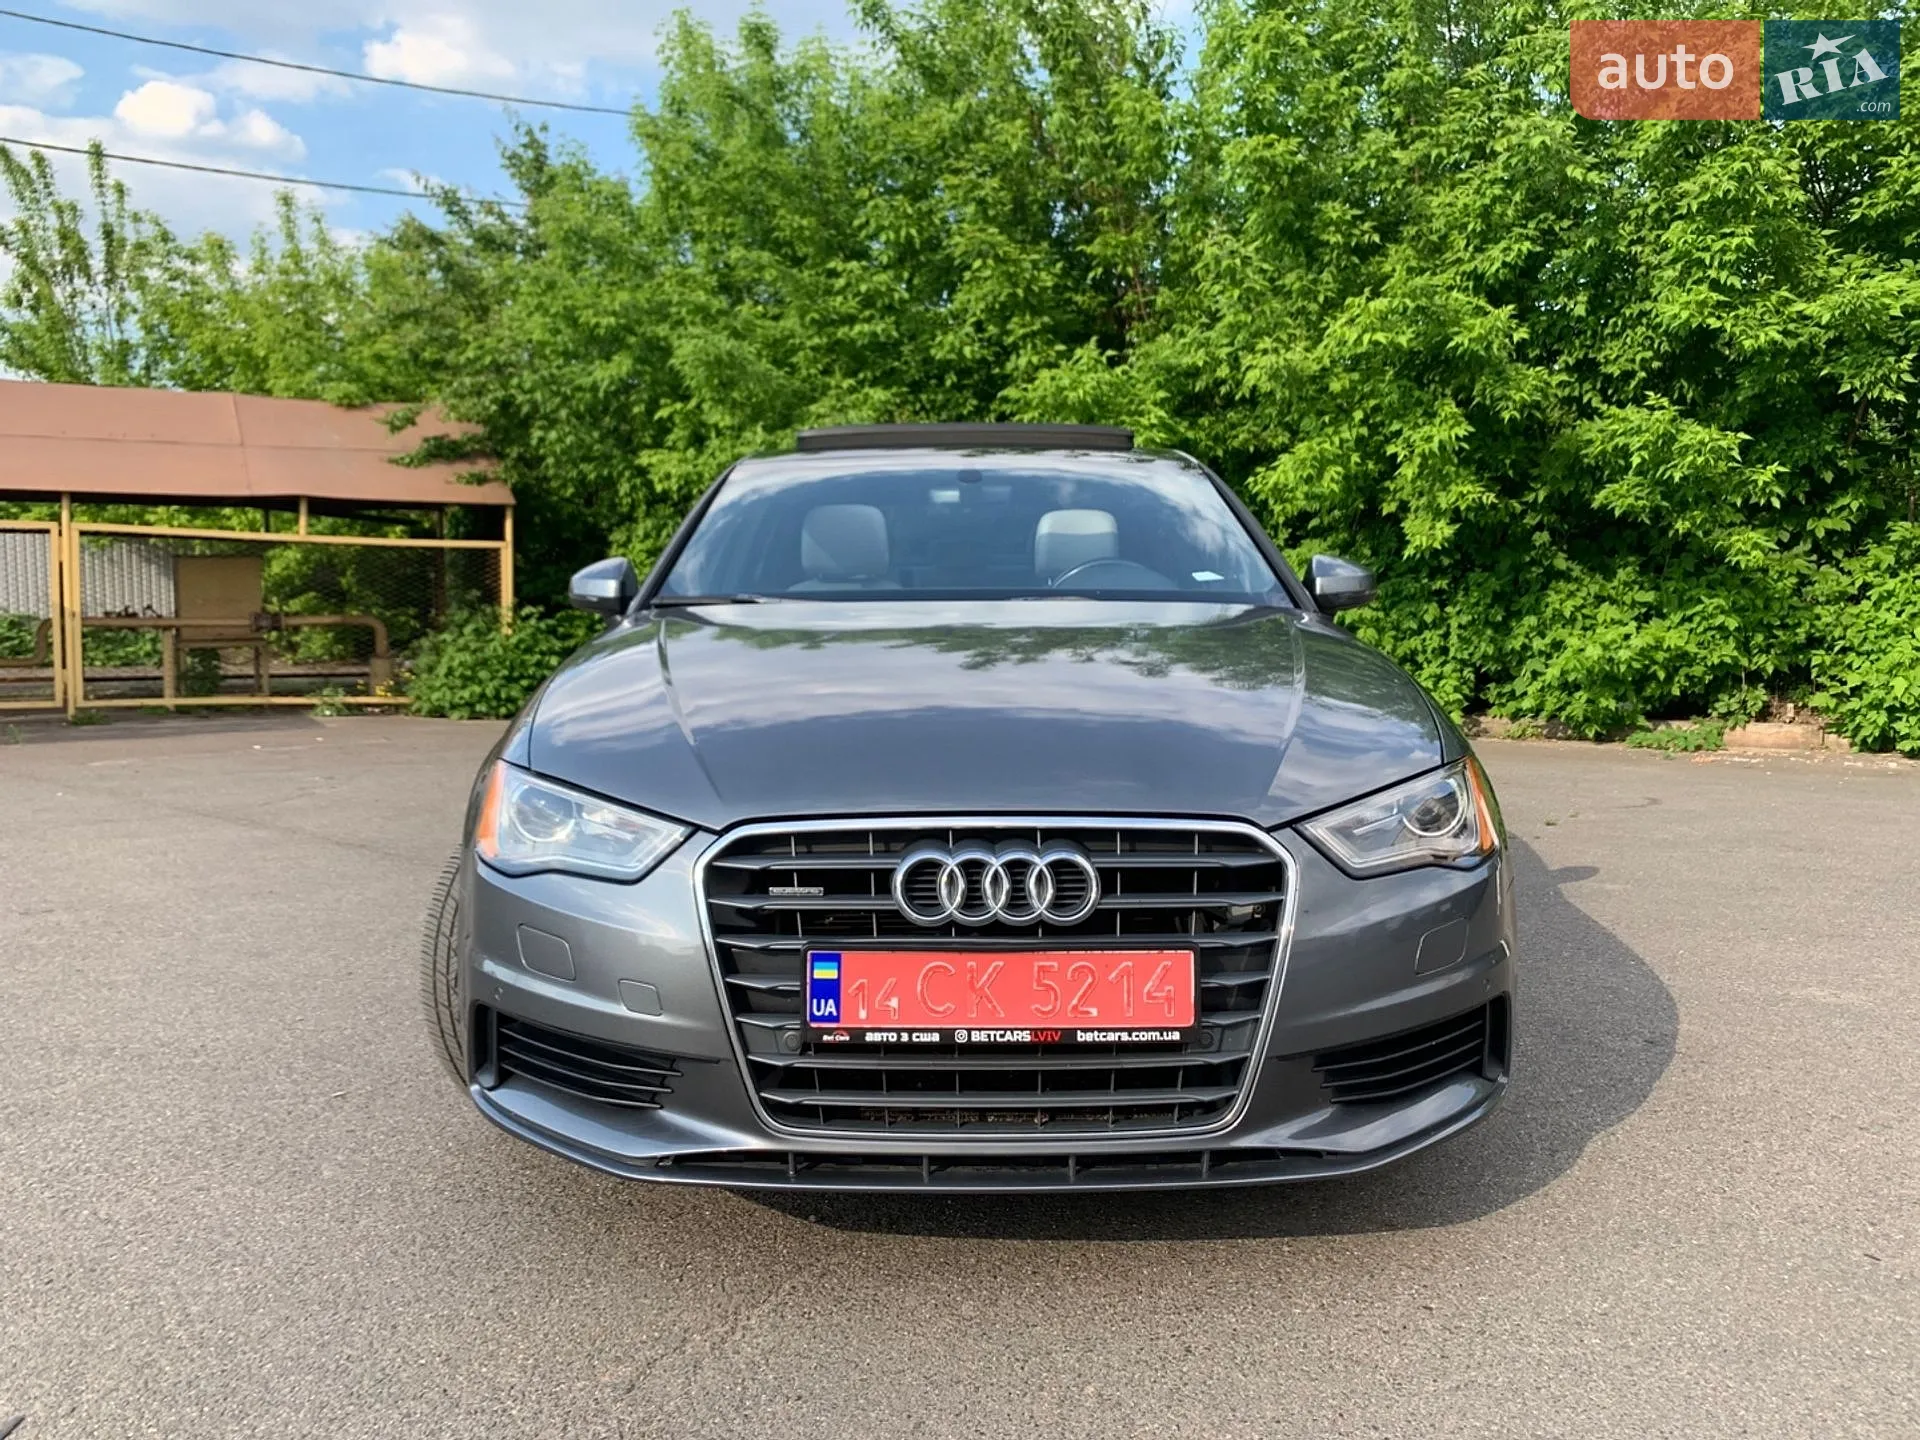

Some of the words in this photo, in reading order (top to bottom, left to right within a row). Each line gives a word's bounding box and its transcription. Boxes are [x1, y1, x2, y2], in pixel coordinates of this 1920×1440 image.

[847, 977, 899, 1020] 14
[917, 961, 1005, 1018] CK
[1031, 961, 1175, 1018] 5214
[812, 998, 838, 1017] UA
[865, 1031, 898, 1042] авто
[1076, 1030, 1181, 1042] betcars.com.ua
